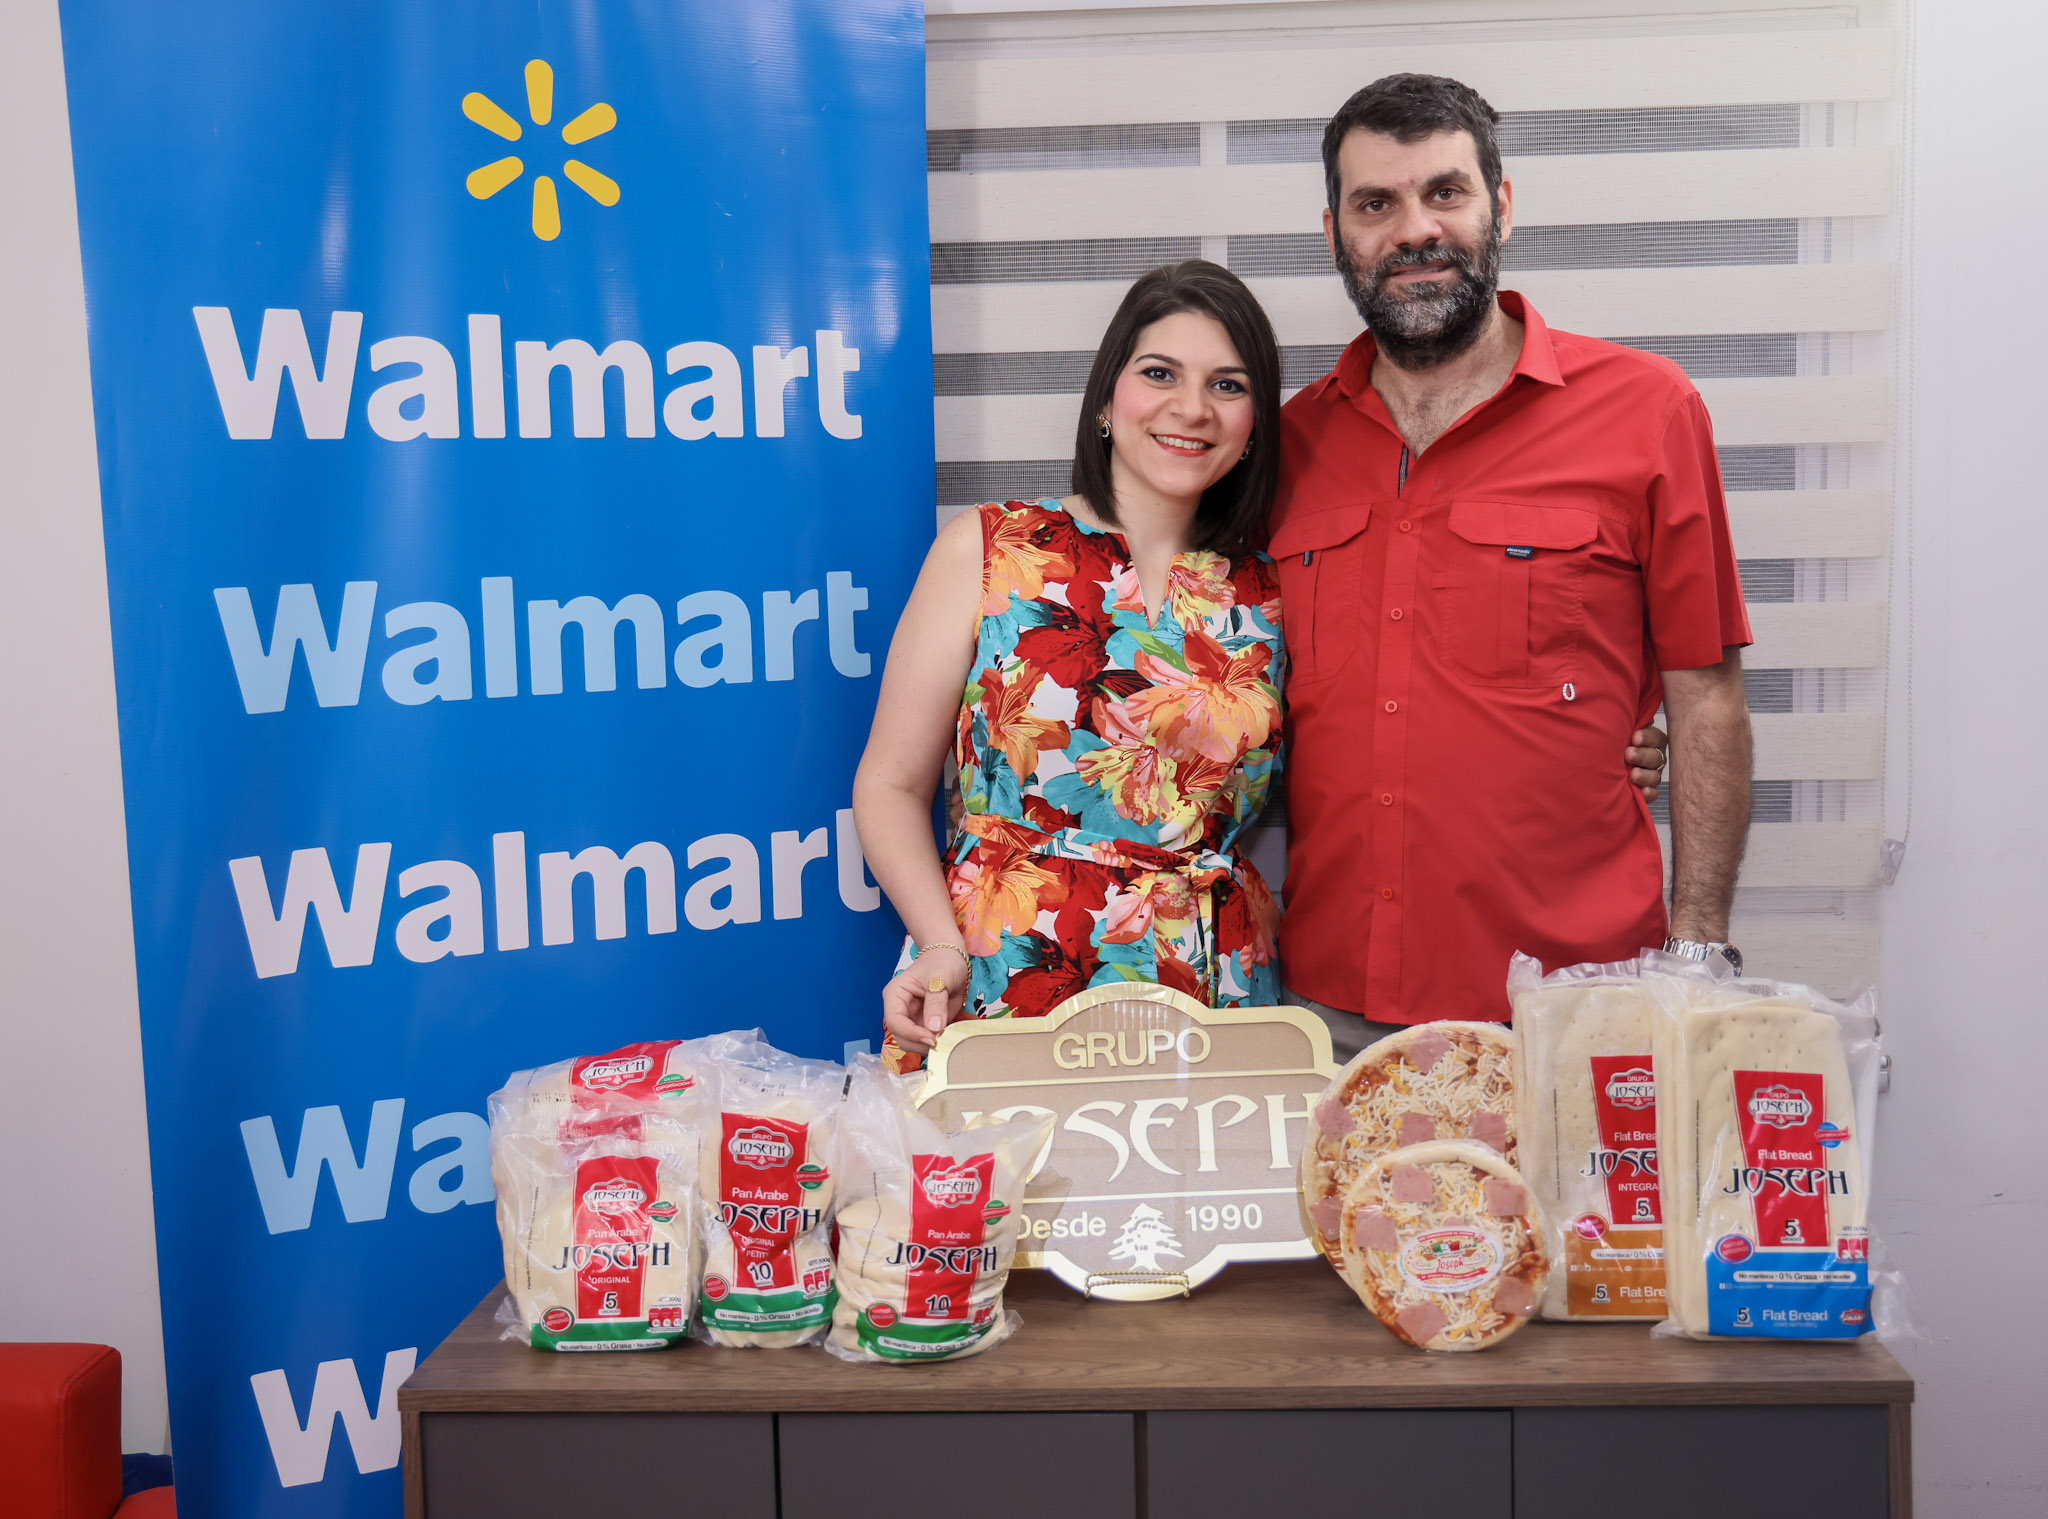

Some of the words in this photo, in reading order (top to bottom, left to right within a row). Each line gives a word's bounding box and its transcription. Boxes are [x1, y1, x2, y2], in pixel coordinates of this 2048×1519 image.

[192, 306, 862, 441] Walmart
[213, 571, 871, 714] Walmart
[1052, 1026, 1211, 1070] GRUPO
[1613, 1085, 1656, 1098] JOSEP
[1752, 1101, 1804, 1114] JOSEPH
[751, 1132, 773, 1141] GRUPO
[961, 1094, 1322, 1184] OSEPH
[1614, 1132, 1632, 1142] Flat
[1633, 1131, 1657, 1141] Brea
[735, 1142, 786, 1157] JOSEPH
[1758, 1149, 1777, 1160] Flat
[1778, 1149, 1813, 1161] Bread
[1579, 1150, 1658, 1177] JOSE
[928, 1181, 976, 1194] JOSEPH
[1618, 1182, 1659, 1192] INTEGRA
[1722, 1167, 1850, 1197] JOSEPH
[590, 1190, 640, 1200] JOSEPH
[731, 1187, 753, 1199] Pan
[754, 1186, 789, 1201] Árabe
[1637, 1199, 1650, 1217] 5
[714, 1201, 822, 1233] JOSEPH
[1017, 1212, 1107, 1240] Desde
[1185, 1203, 1263, 1233] 1990
[588, 1229, 608, 1239] Pan
[609, 1226, 639, 1238] Árabe
[927, 1229, 945, 1239] Pan
[1784, 1219, 1798, 1238] 5
[741, 1235, 776, 1247] ORIGINAL
[552, 1241, 672, 1272] JOSEPH
[885, 1241, 998, 1274] JOSEPH
[749, 1261, 772, 1281] 10
[1436, 1256, 1464, 1273] Joseph
[591, 1276, 631, 1285] ORIGINAL
[1794, 1272, 1818, 1281] Grasa
[1596, 1285, 1607, 1300] 5
[1620, 1286, 1642, 1298] Flat
[1644, 1286, 1666, 1298] Bre
[604, 1292, 619, 1310] 5
[926, 1293, 950, 1311] 10
[1737, 1307, 1749, 1322] 5
[1762, 1309, 1786, 1321] Flat
[1788, 1309, 1829, 1322] Bread
